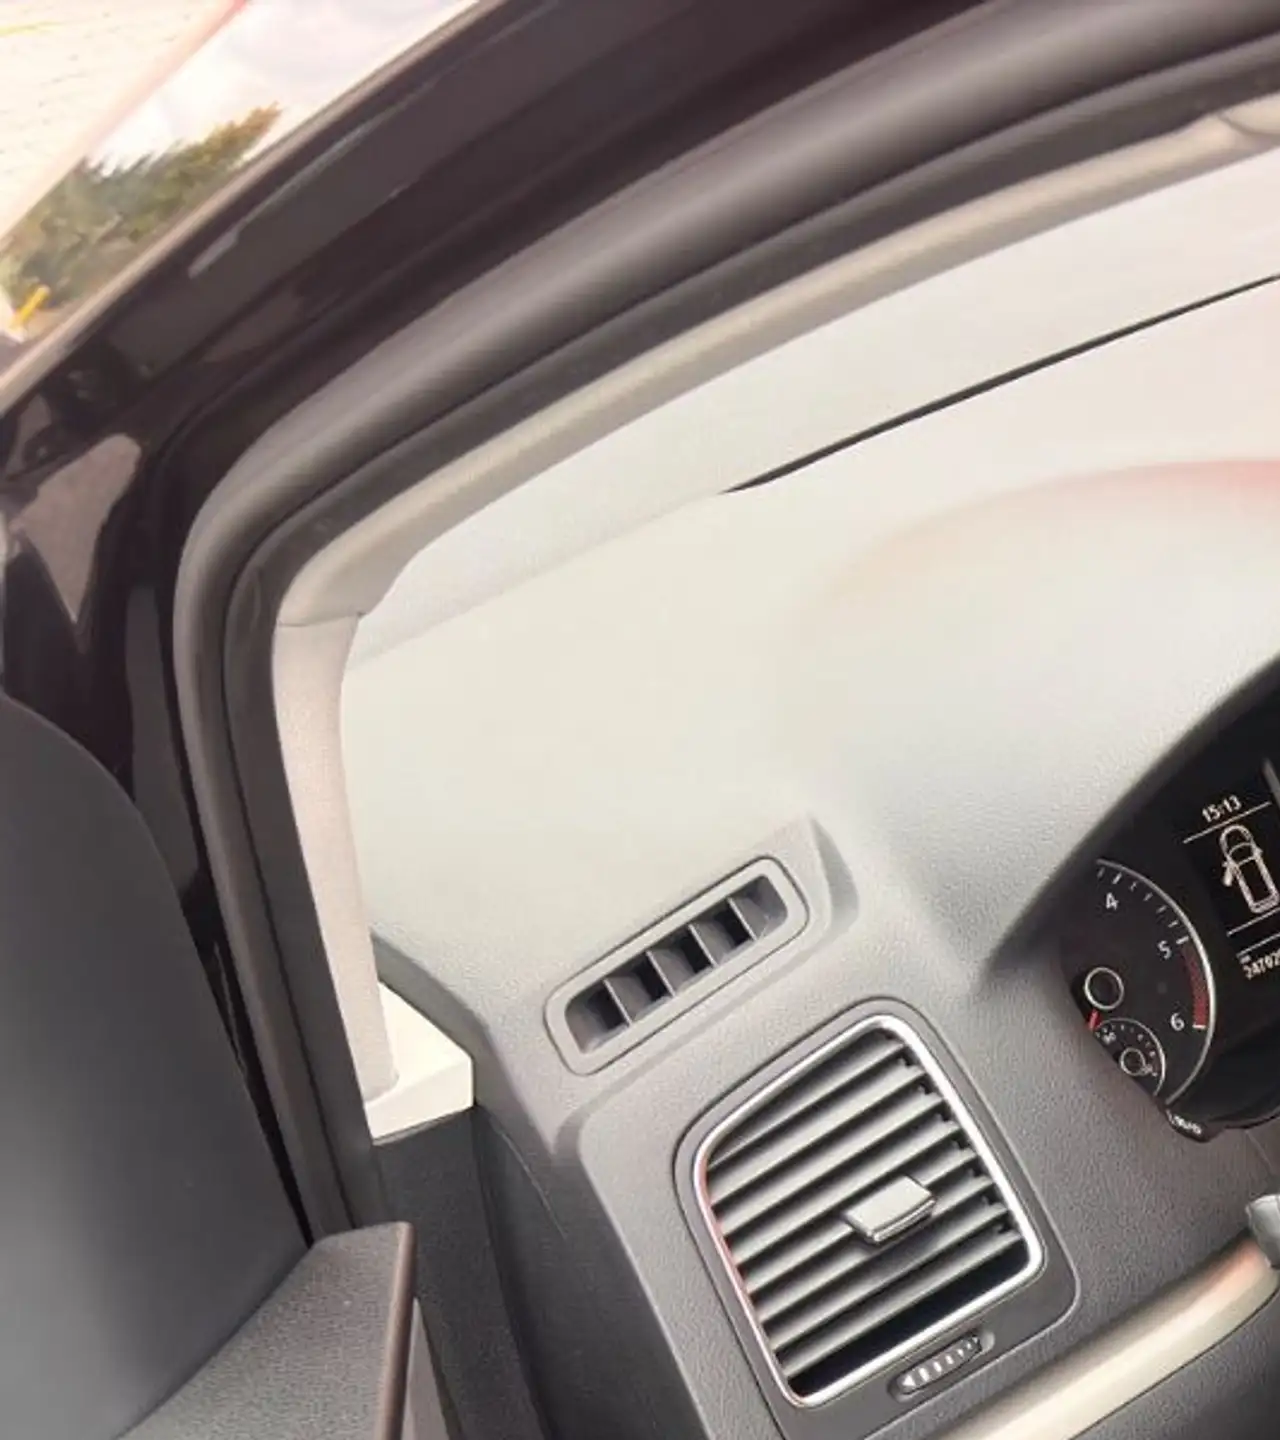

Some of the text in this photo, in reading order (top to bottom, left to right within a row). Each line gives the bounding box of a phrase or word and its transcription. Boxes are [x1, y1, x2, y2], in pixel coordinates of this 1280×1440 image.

[1201, 795, 1242, 823] 15:13
[1106, 891, 1118, 911] 4
[1156, 939, 1172, 960] 5
[1169, 1011, 1186, 1032] 6
